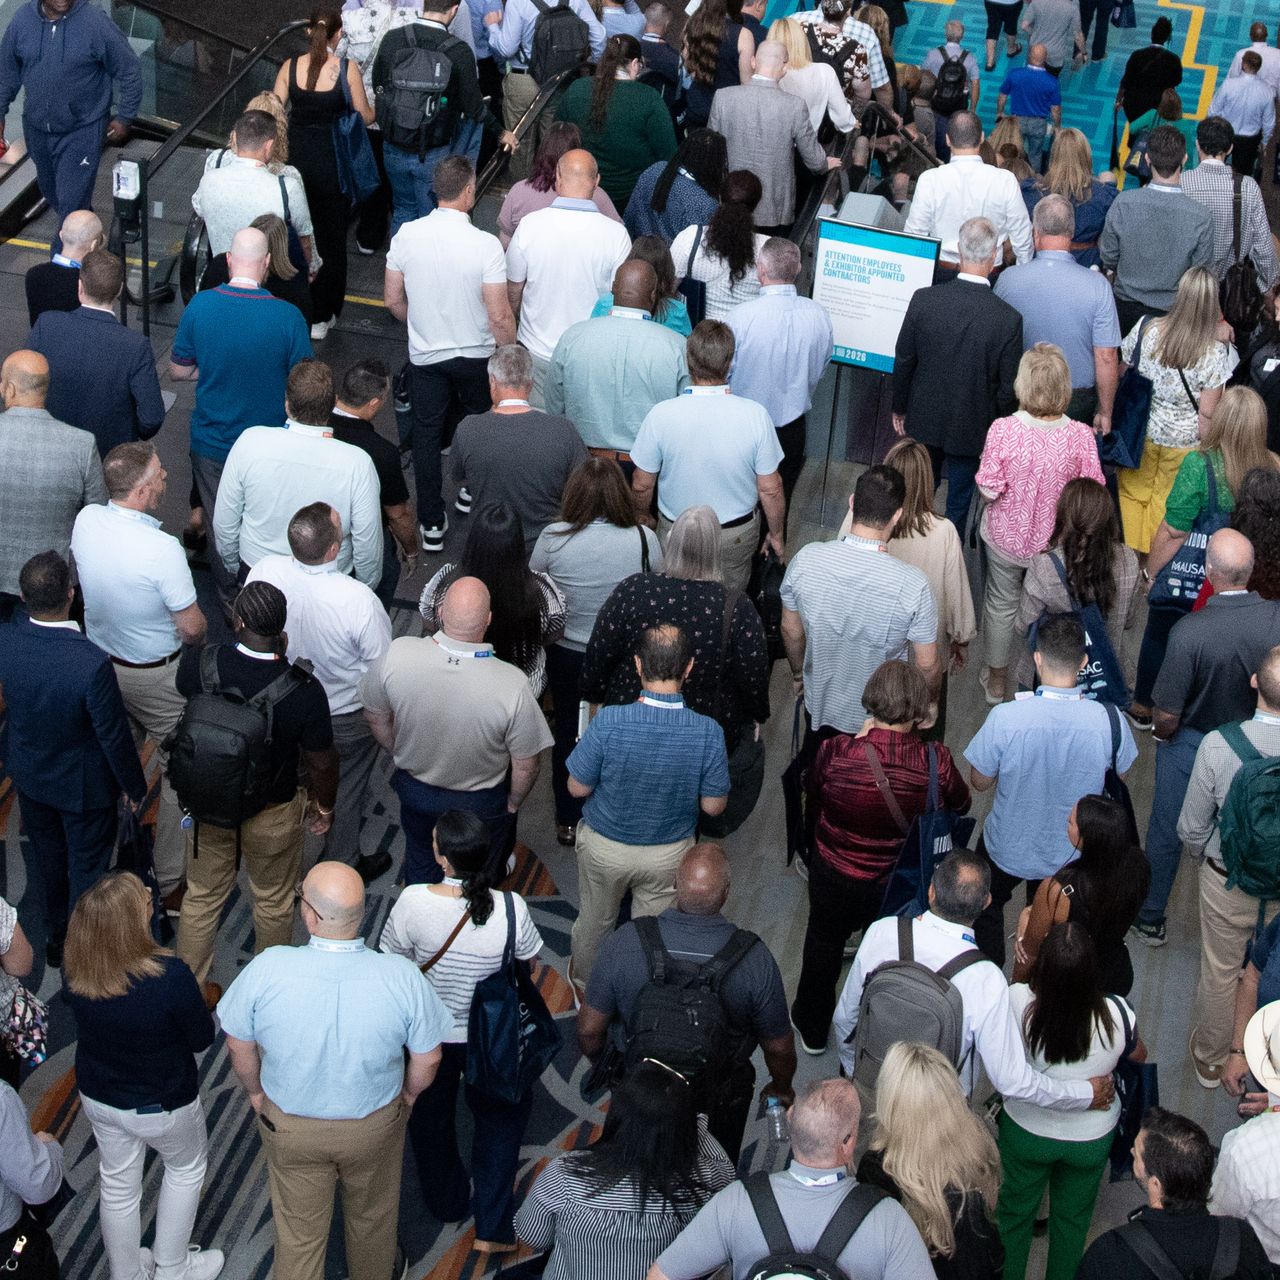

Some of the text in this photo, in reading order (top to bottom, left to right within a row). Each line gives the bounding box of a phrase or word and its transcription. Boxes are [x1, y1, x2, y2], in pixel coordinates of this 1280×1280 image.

[824, 250, 903, 273] ATTENTION EMPLOYEES
[822, 267, 872, 285] CONTRACTORS
[831, 261, 868, 275] EXHIBITOR
[868, 269, 906, 283] APPOINTED
[845, 348, 867, 362] 2026
[1188, 531, 1212, 550] IDDB
